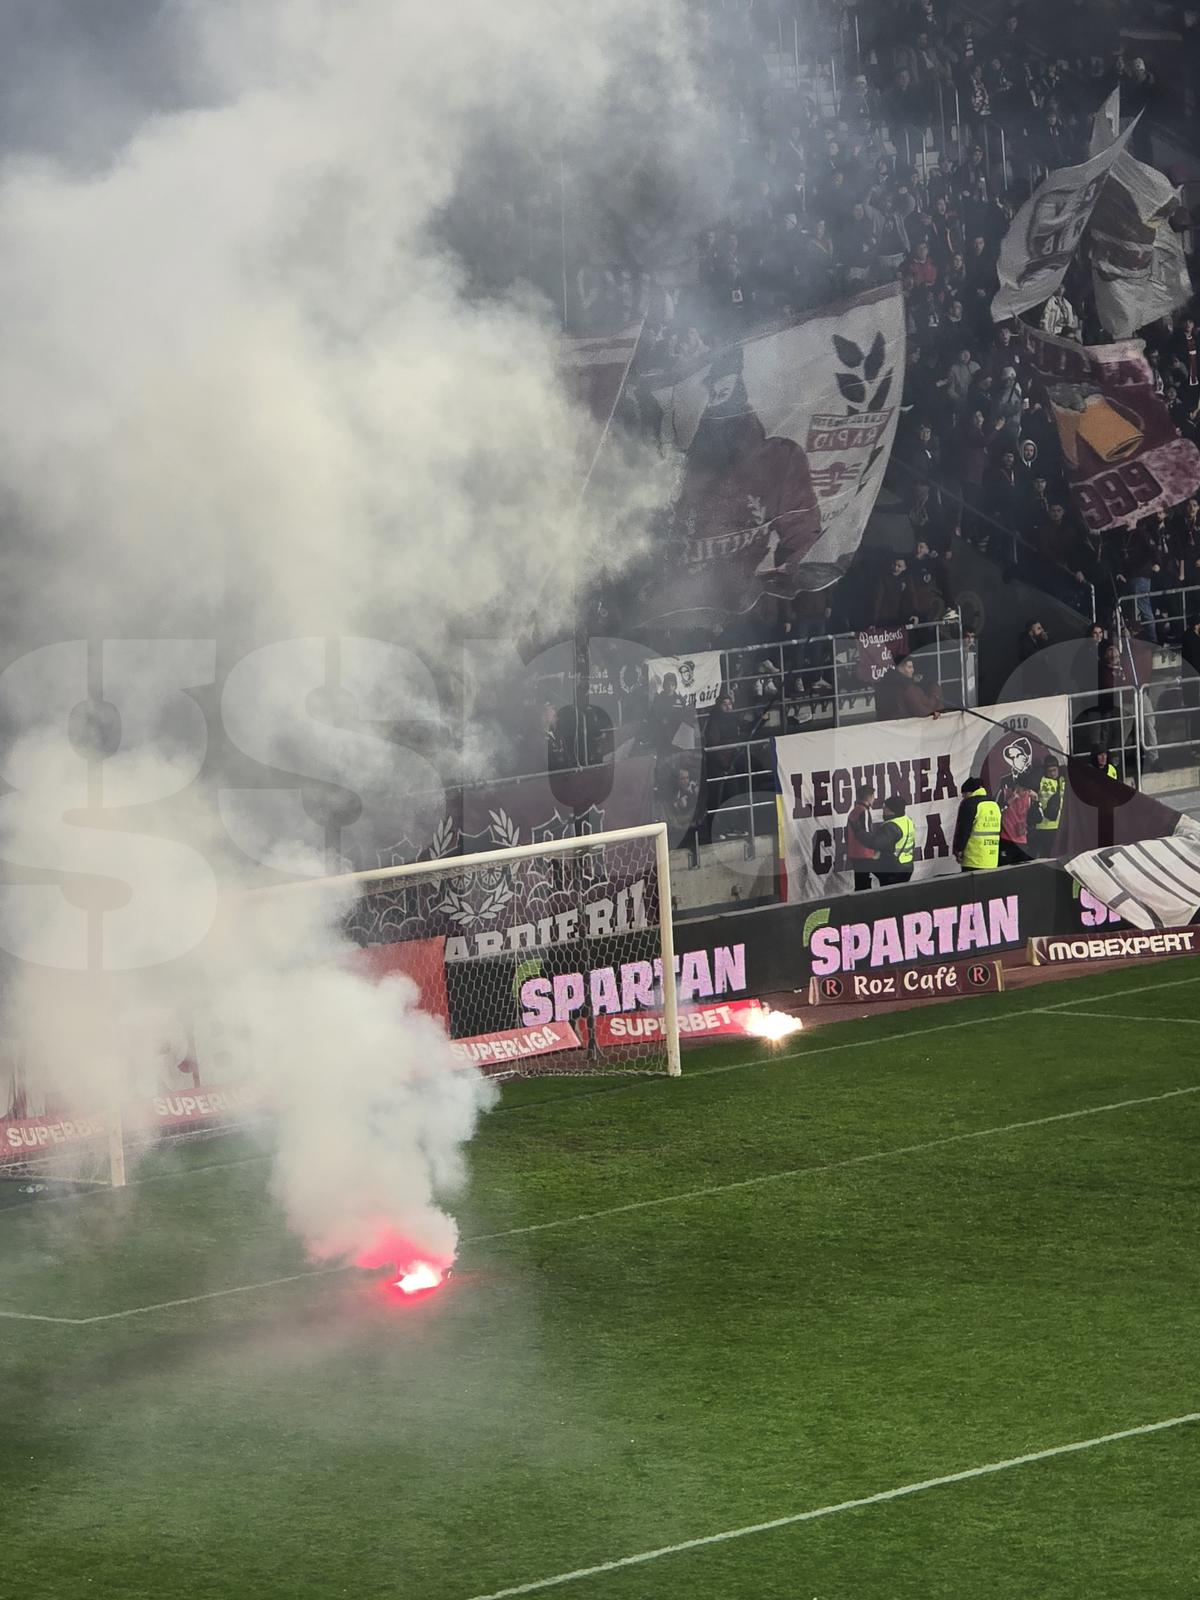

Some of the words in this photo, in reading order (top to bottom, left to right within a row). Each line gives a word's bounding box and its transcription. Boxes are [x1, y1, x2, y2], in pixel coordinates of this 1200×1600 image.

[881, 647, 893, 660] de
[809, 895, 1020, 976] SPARTAN
[1048, 932, 1194, 961] MOBEXPERT
[520, 943, 747, 1027] SPARTAN
[854, 976, 896, 996] Roz
[903, 967, 958, 991] Café
[609, 1006, 732, 1038] SUPERBET
